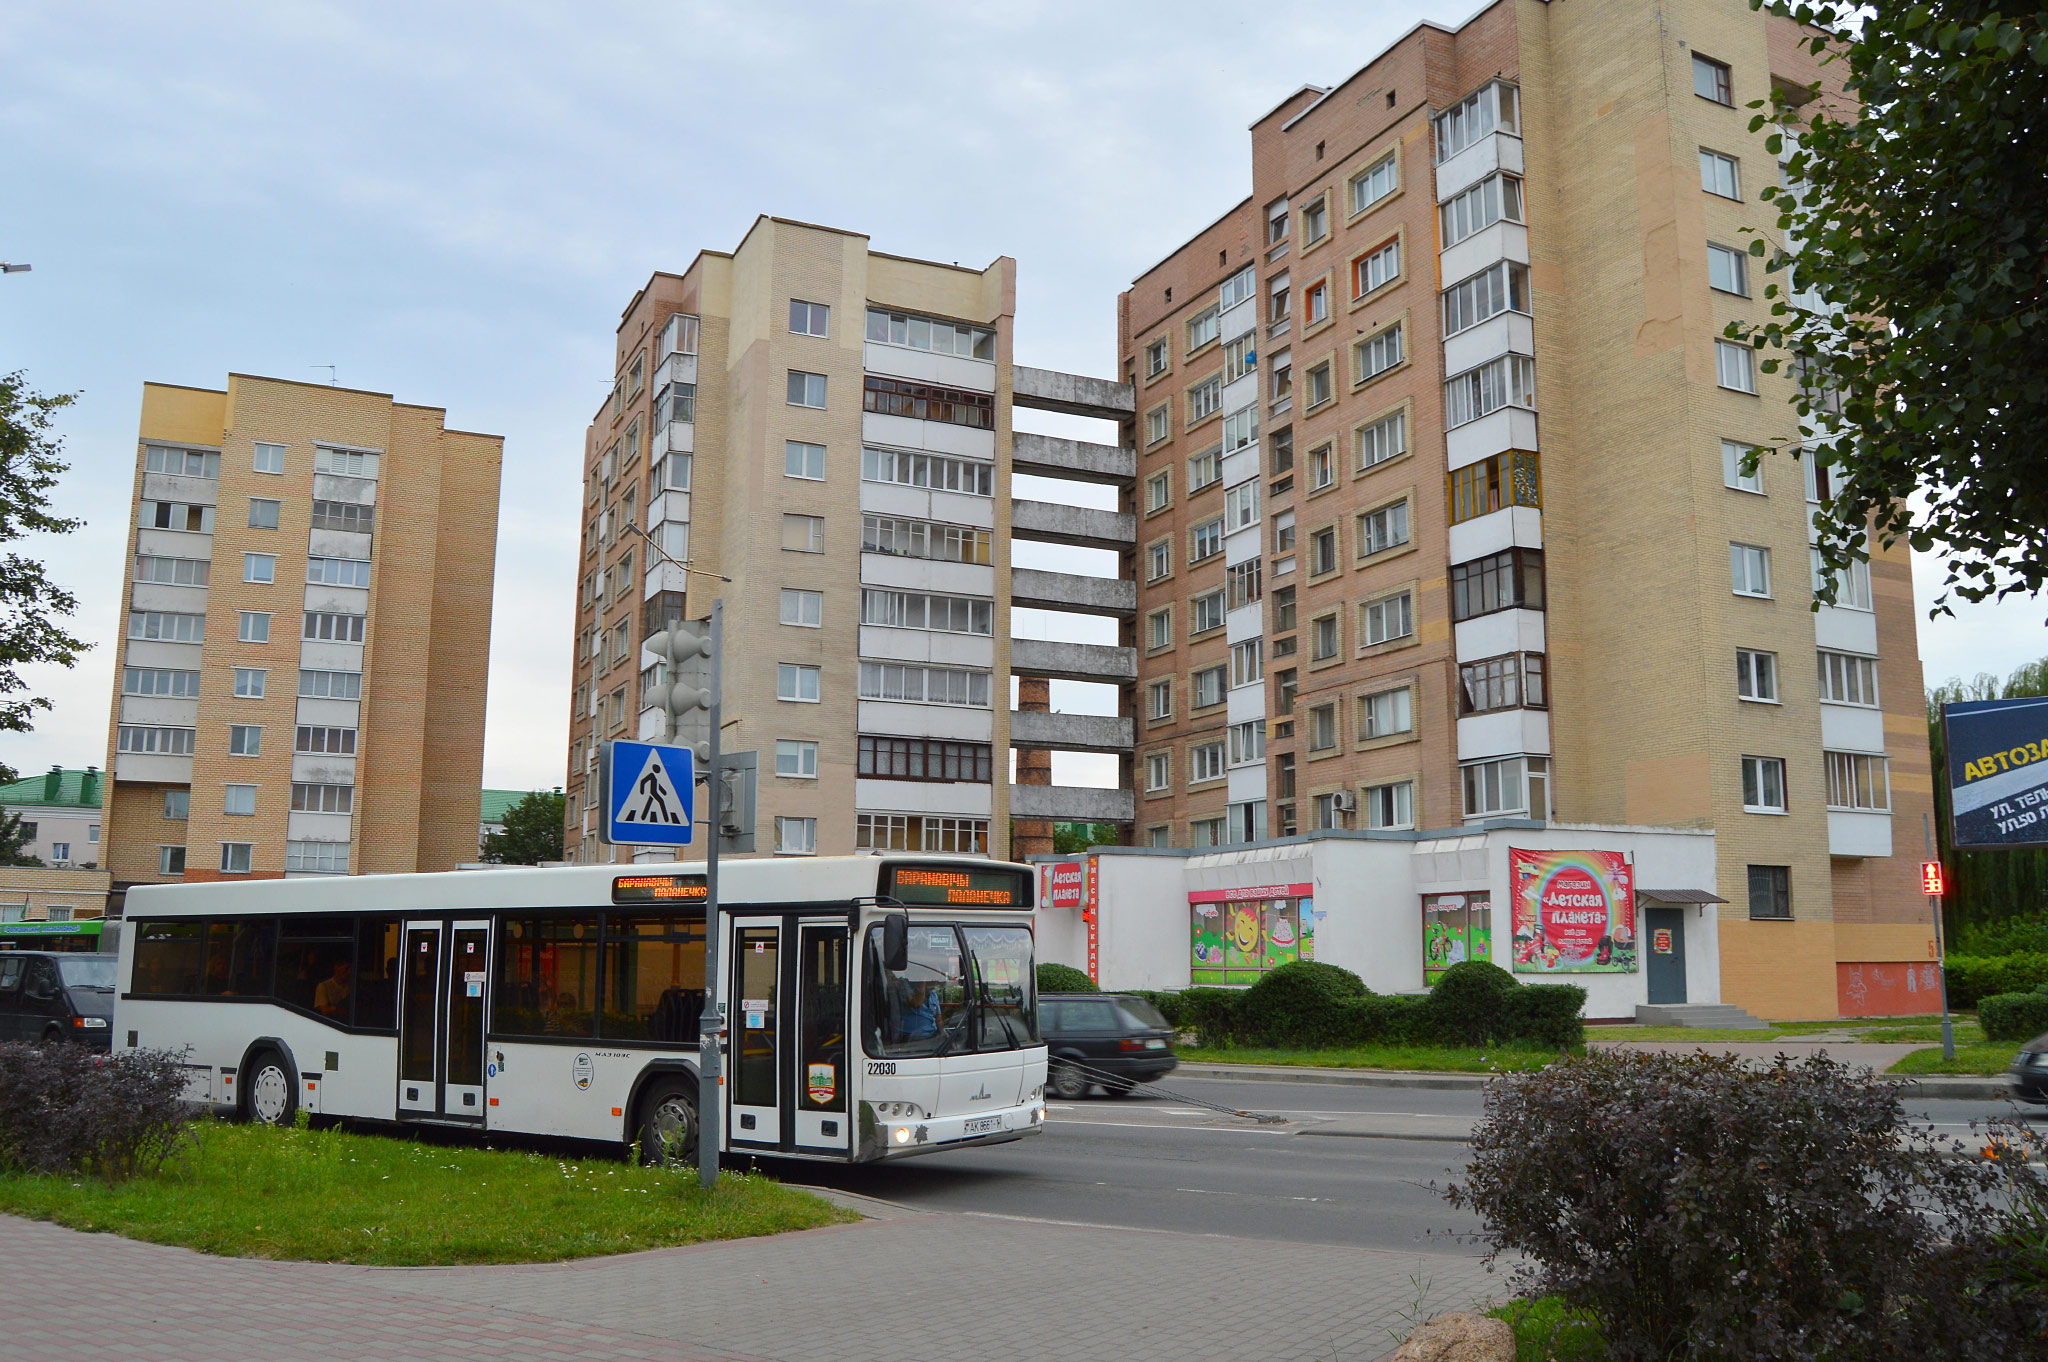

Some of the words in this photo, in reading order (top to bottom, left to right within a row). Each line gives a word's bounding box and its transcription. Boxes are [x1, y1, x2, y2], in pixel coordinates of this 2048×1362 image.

[897, 869, 969, 887] БАРАНАВІЧЫ
[1053, 871, 1082, 884] Детская
[947, 889, 1011, 904] ПАЛАНЕЧКА
[868, 1063, 896, 1075] 22030
